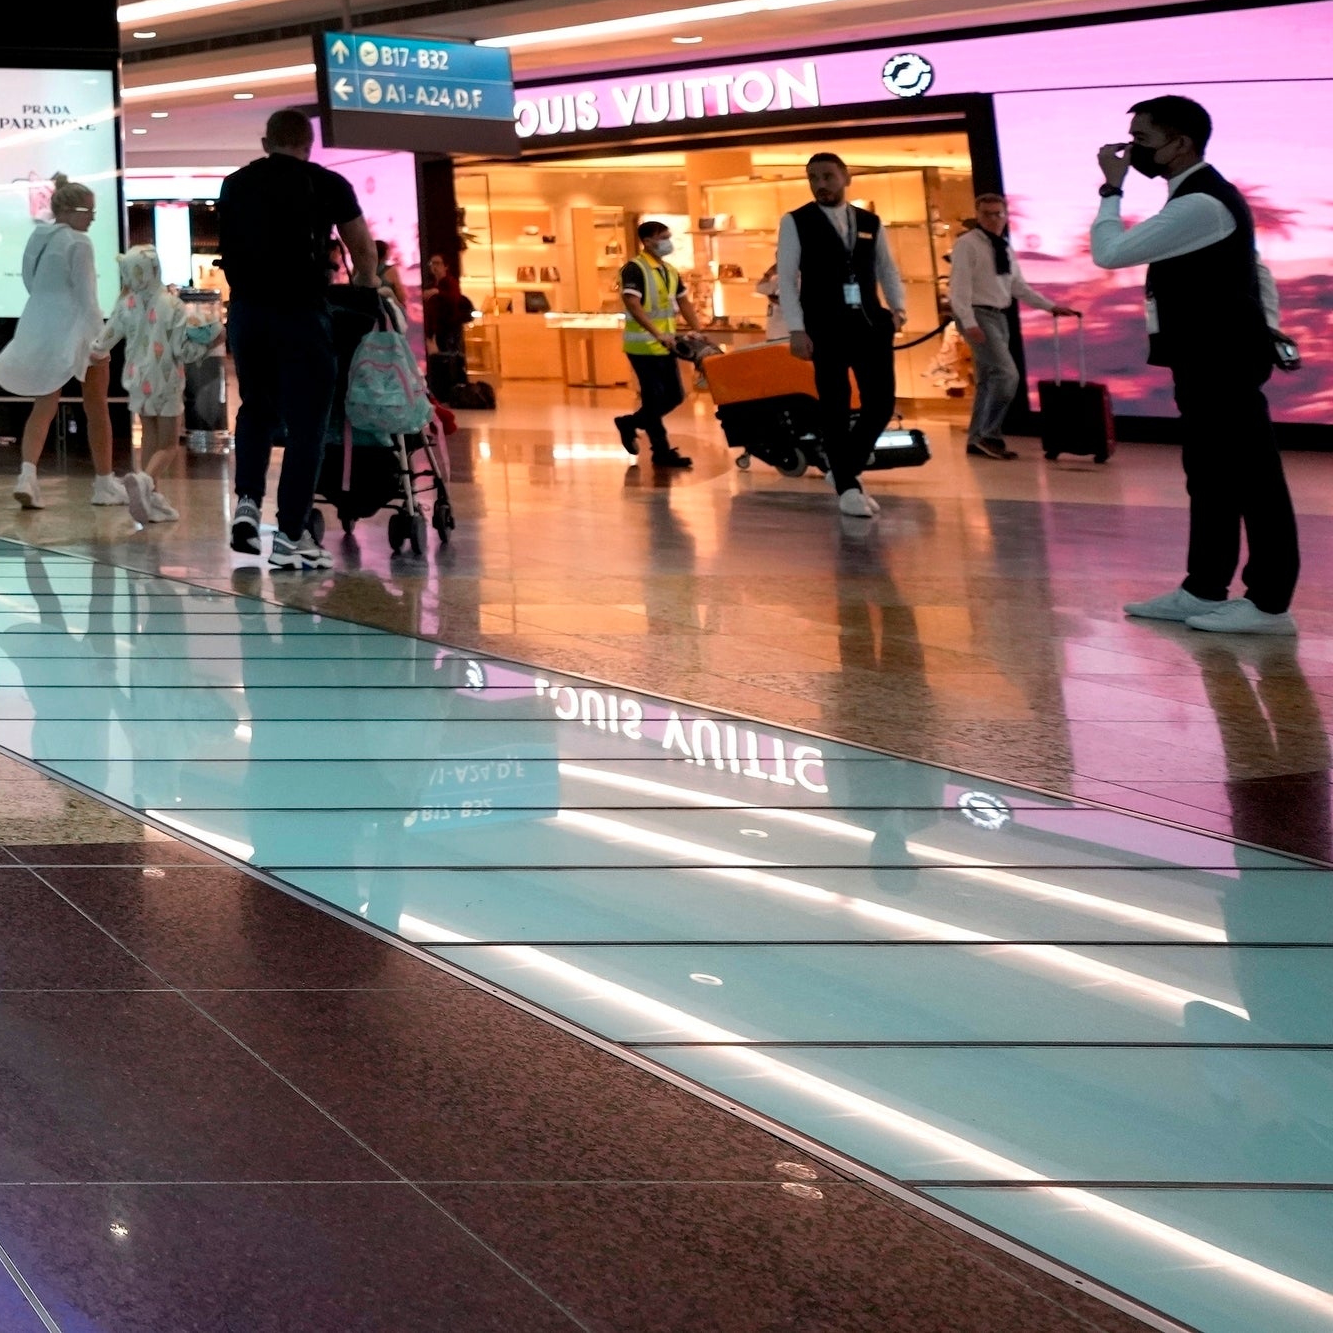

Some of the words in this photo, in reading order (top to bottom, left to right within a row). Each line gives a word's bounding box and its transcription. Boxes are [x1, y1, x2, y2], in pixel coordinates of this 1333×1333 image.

[380, 46, 449, 70] B17-B32
[514, 90, 600, 138] OUIS
[612, 62, 820, 124] VUITTON
[22, 105, 70, 115] PRADA
[0, 117, 97, 131] PARADE
